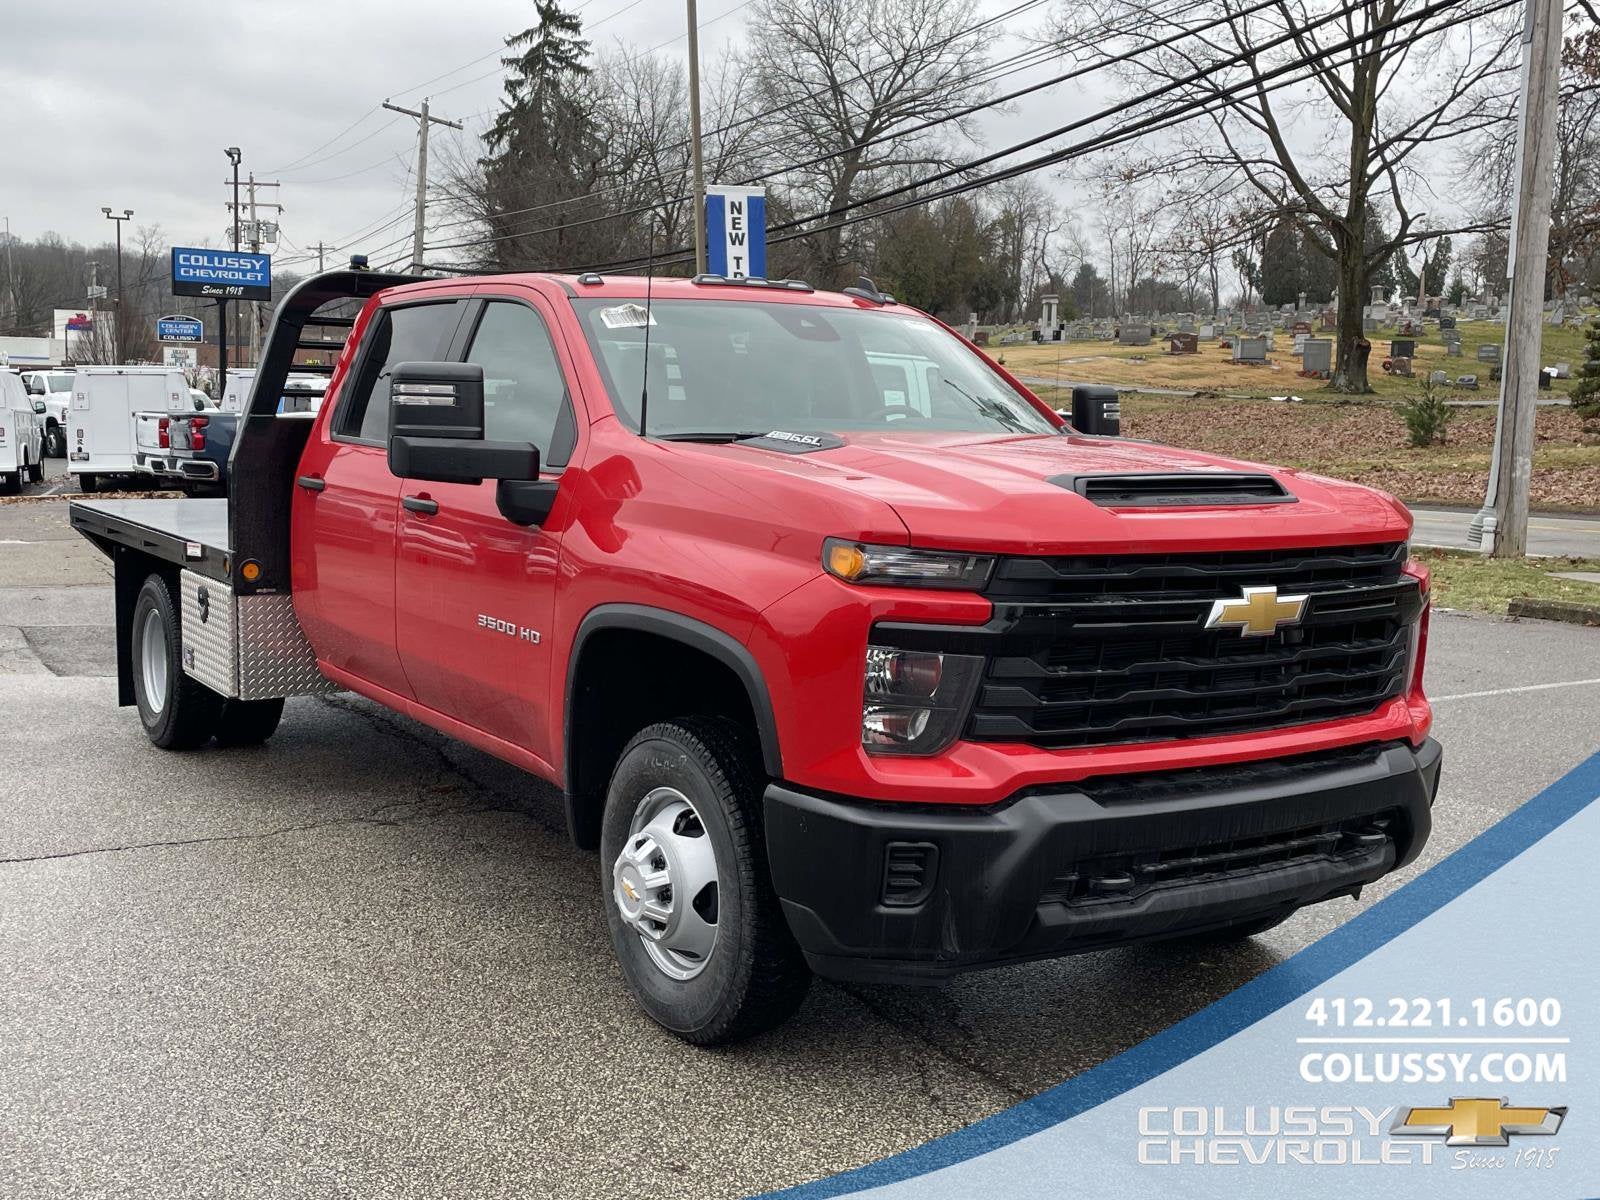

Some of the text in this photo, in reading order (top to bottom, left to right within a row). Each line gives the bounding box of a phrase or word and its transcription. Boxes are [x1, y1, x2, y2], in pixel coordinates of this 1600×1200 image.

[729, 201, 745, 245] NEW
[179, 254, 264, 270] COLUSSY
[180, 267, 264, 281] CHEVROLET
[201, 285, 244, 295] Since 1918
[478, 614, 541, 644] 3500 HD
